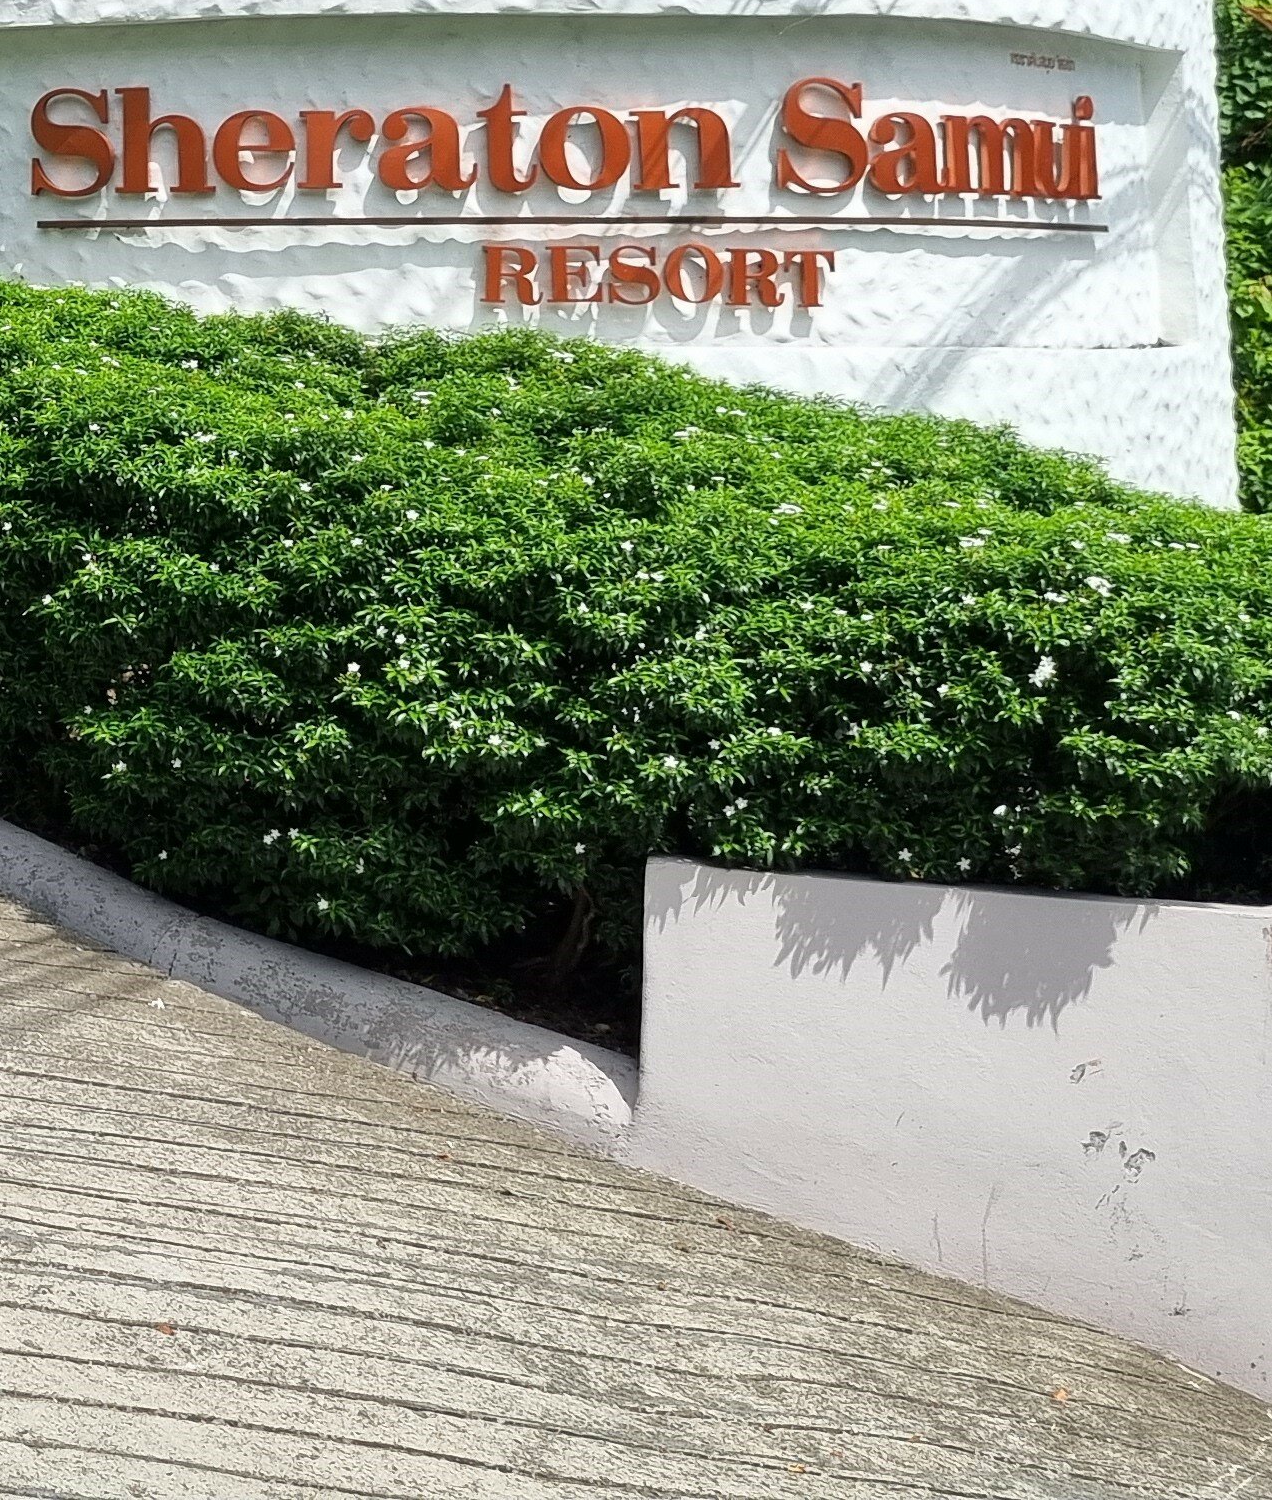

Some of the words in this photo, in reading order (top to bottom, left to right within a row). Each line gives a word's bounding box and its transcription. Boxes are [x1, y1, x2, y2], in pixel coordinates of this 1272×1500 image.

[30, 83, 740, 197] Sheraton
[777, 76, 1101, 200] Samui
[480, 244, 836, 308] RESORT
